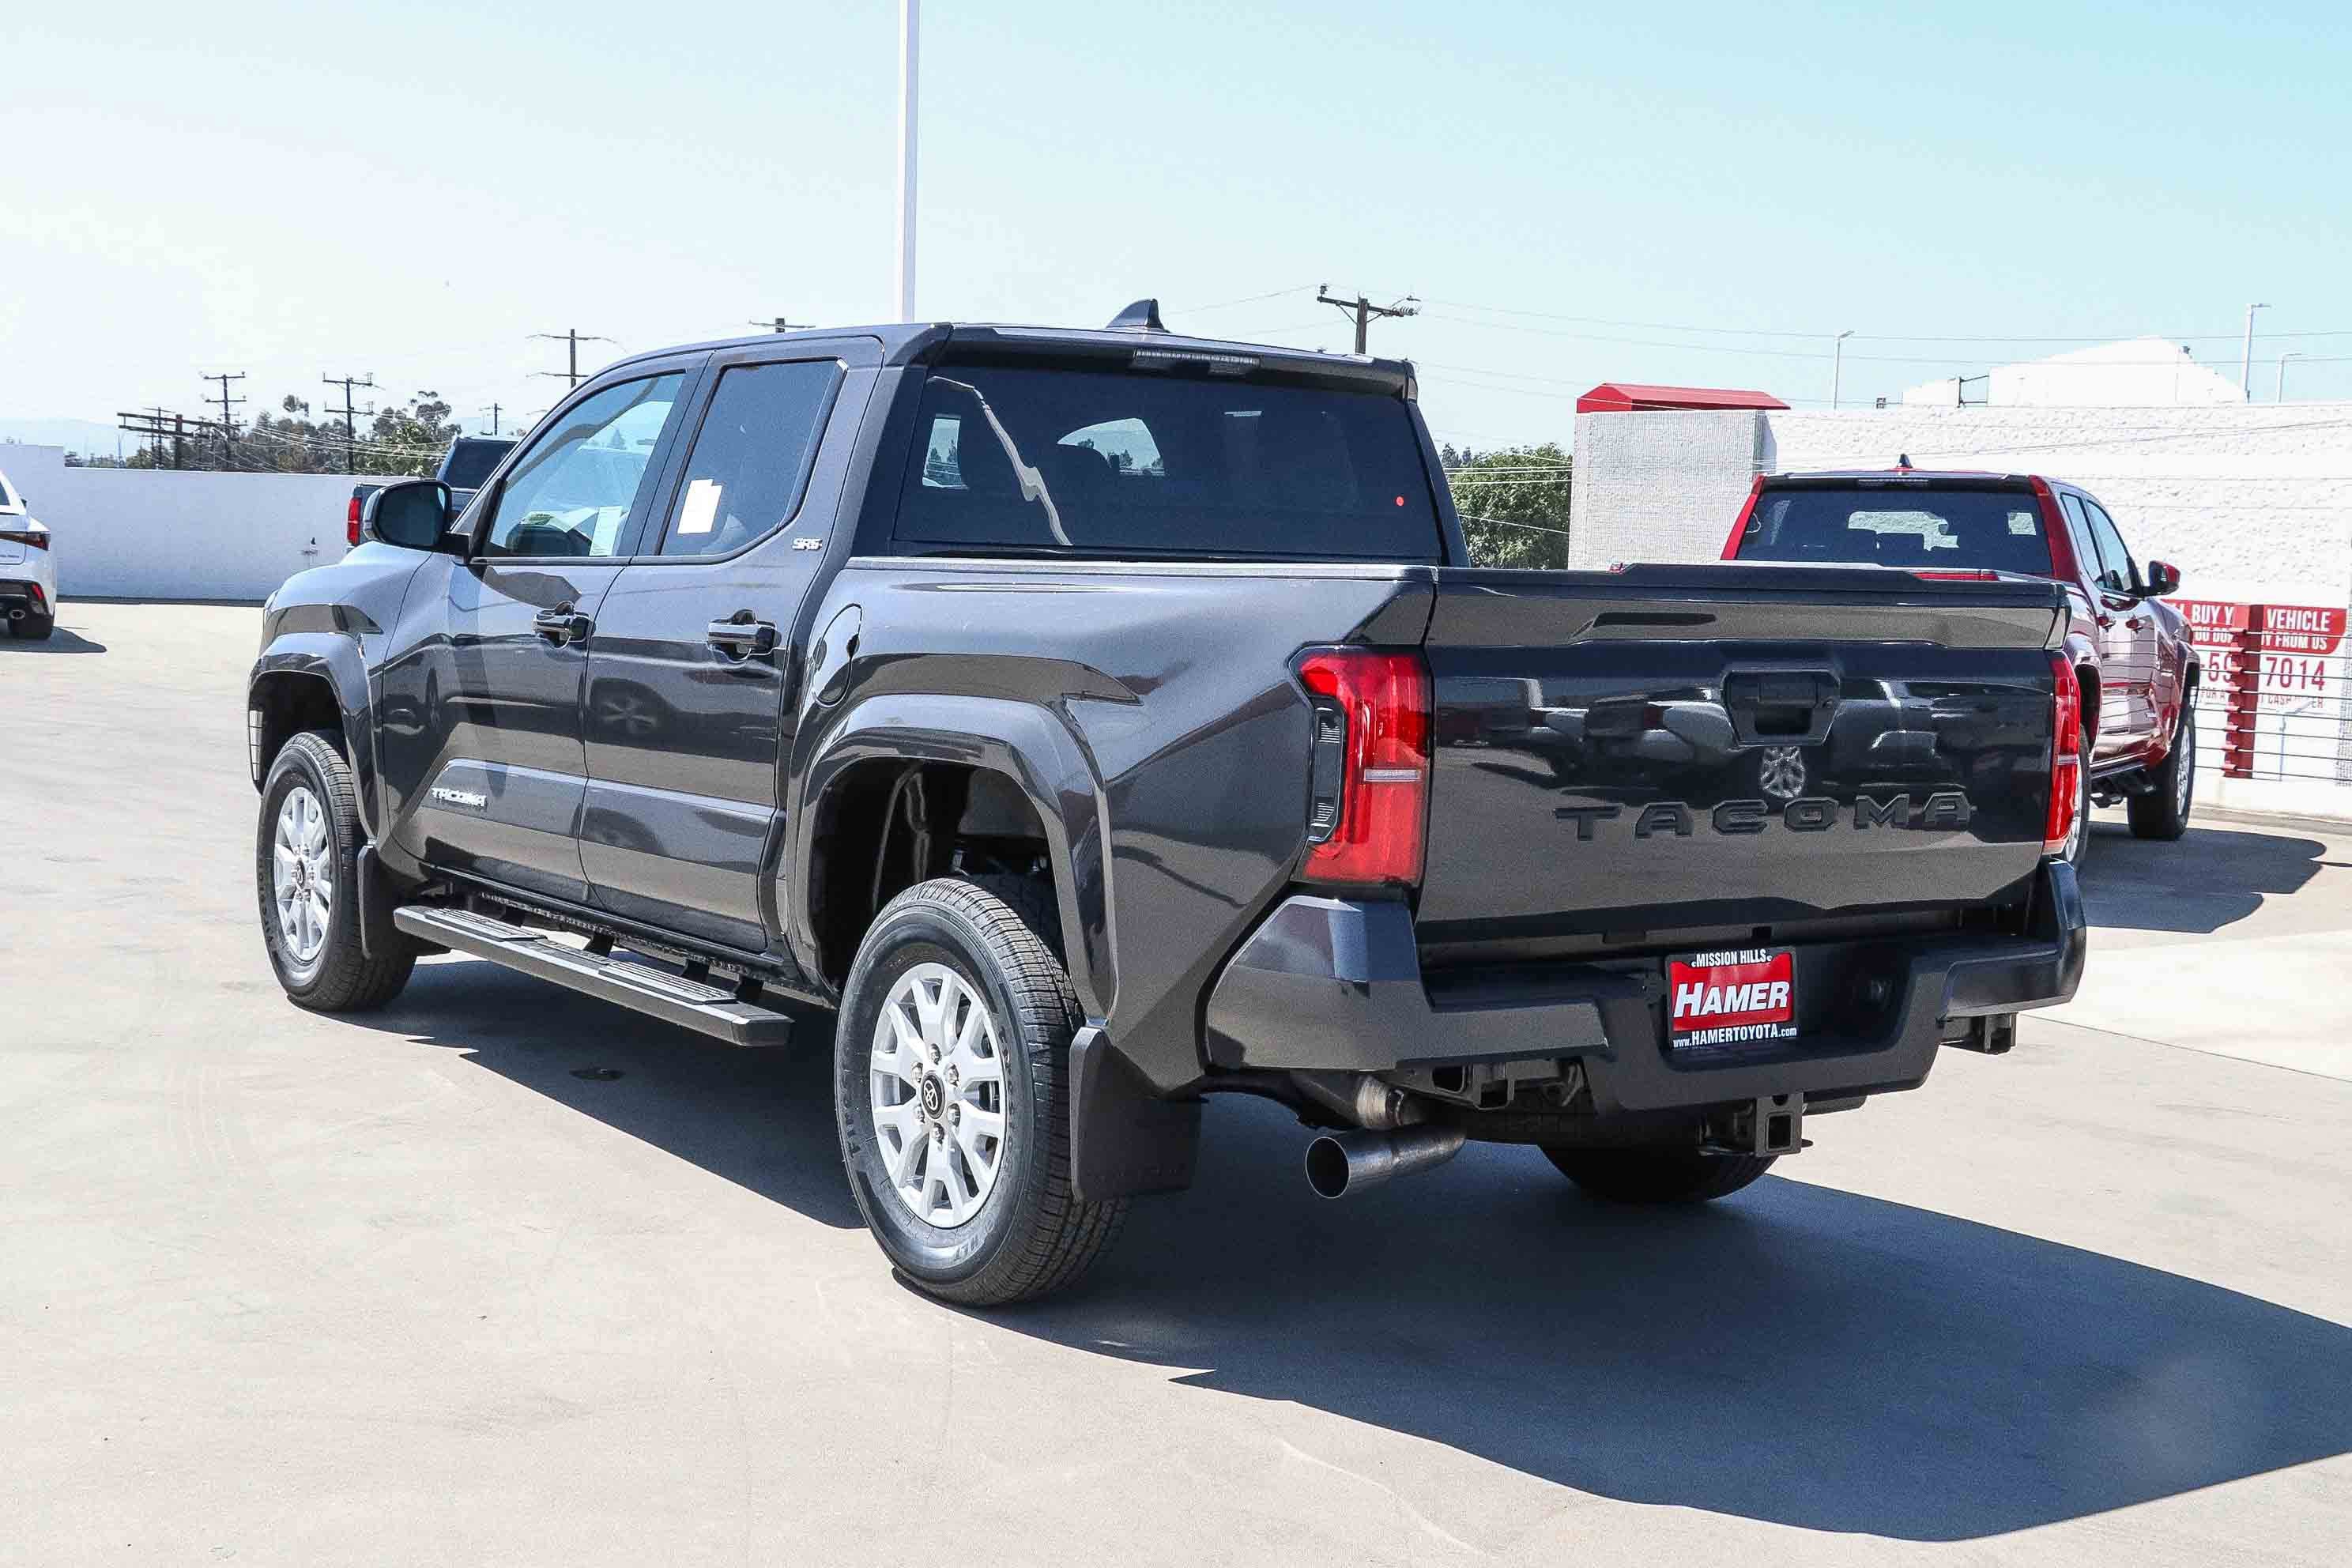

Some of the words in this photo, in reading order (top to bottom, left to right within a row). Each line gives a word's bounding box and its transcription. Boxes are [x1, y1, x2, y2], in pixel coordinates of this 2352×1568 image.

[2192, 605, 2220, 624] BUY
[2267, 608, 2331, 631] VEHICLE
[2312, 635, 2328, 650] US
[1555, 791, 1973, 842] TACOMA
[1696, 951, 1738, 967] MISSION
[1740, 948, 1767, 964] HILLS
[1673, 981, 1790, 1018] HAMER
[1673, 1023, 1797, 1048] www.HAMERTOYOTA.com
